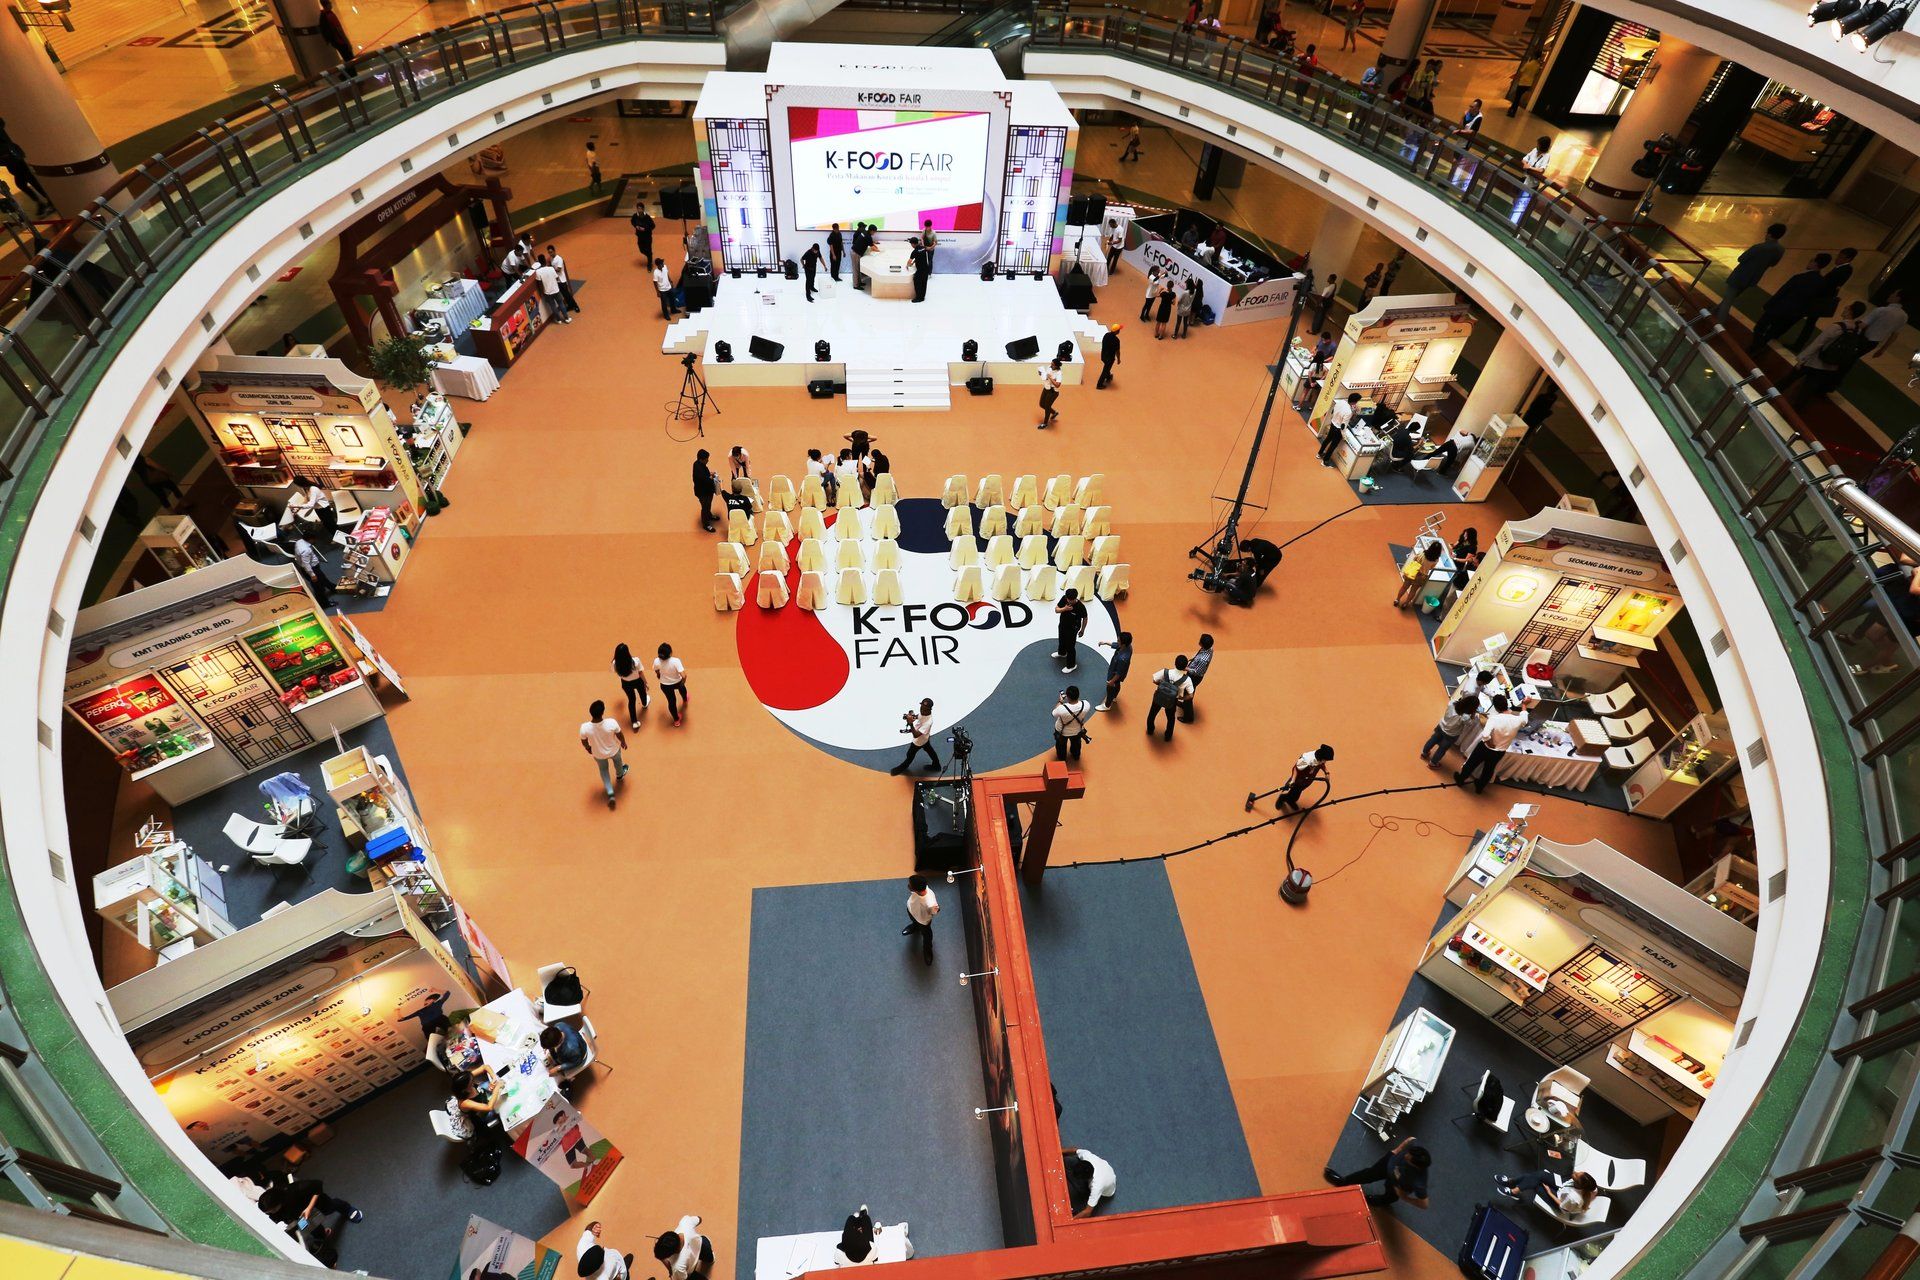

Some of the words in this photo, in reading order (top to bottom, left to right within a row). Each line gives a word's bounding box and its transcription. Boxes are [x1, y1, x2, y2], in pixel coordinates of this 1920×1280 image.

[858, 92, 896, 103] K-FOOD
[899, 94, 922, 103] FAIR
[826, 151, 903, 170] K-FOOD
[910, 153, 954, 171] FAIR
[378, 205, 394, 222] OPEN
[393, 191, 417, 211] KITCHEN
[1143, 244, 1180, 275] K-FOOD
[1236, 295, 1269, 307] K-FOOD
[1270, 292, 1289, 302] FAIR
[1567, 557, 1598, 568] SEOKANG
[1598, 563, 1618, 572] DAIRY
[1624, 568, 1643, 577] FOOD
[853, 601, 1033, 635] K-FOOD
[132, 646, 152, 658] KMT
[152, 633, 191, 651] TRADING
[191, 626, 213, 638] SDN.
[213, 618, 234, 629] BHD.
[854, 635, 961, 669] FAIR
[203, 692, 237, 709] K-FOOD
[238, 683, 258, 695] FAIR
[1641, 945, 1678, 969] TEAZEN
[1561, 979, 1599, 1004] K-FOOD
[1599, 1003, 1623, 1019] FAIR
[183, 1021, 229, 1046] K-FOOD
[230, 999, 273, 1022] ONLINE
[273, 983, 305, 1001] ZONE
[194, 1047, 246, 1075] K-Food
[246, 1016, 312, 1049] Shopping
[311, 999, 345, 1017] Zone
[215, 1065, 233, 1074] Get
[537, 1138, 557, 1162] K-Food
